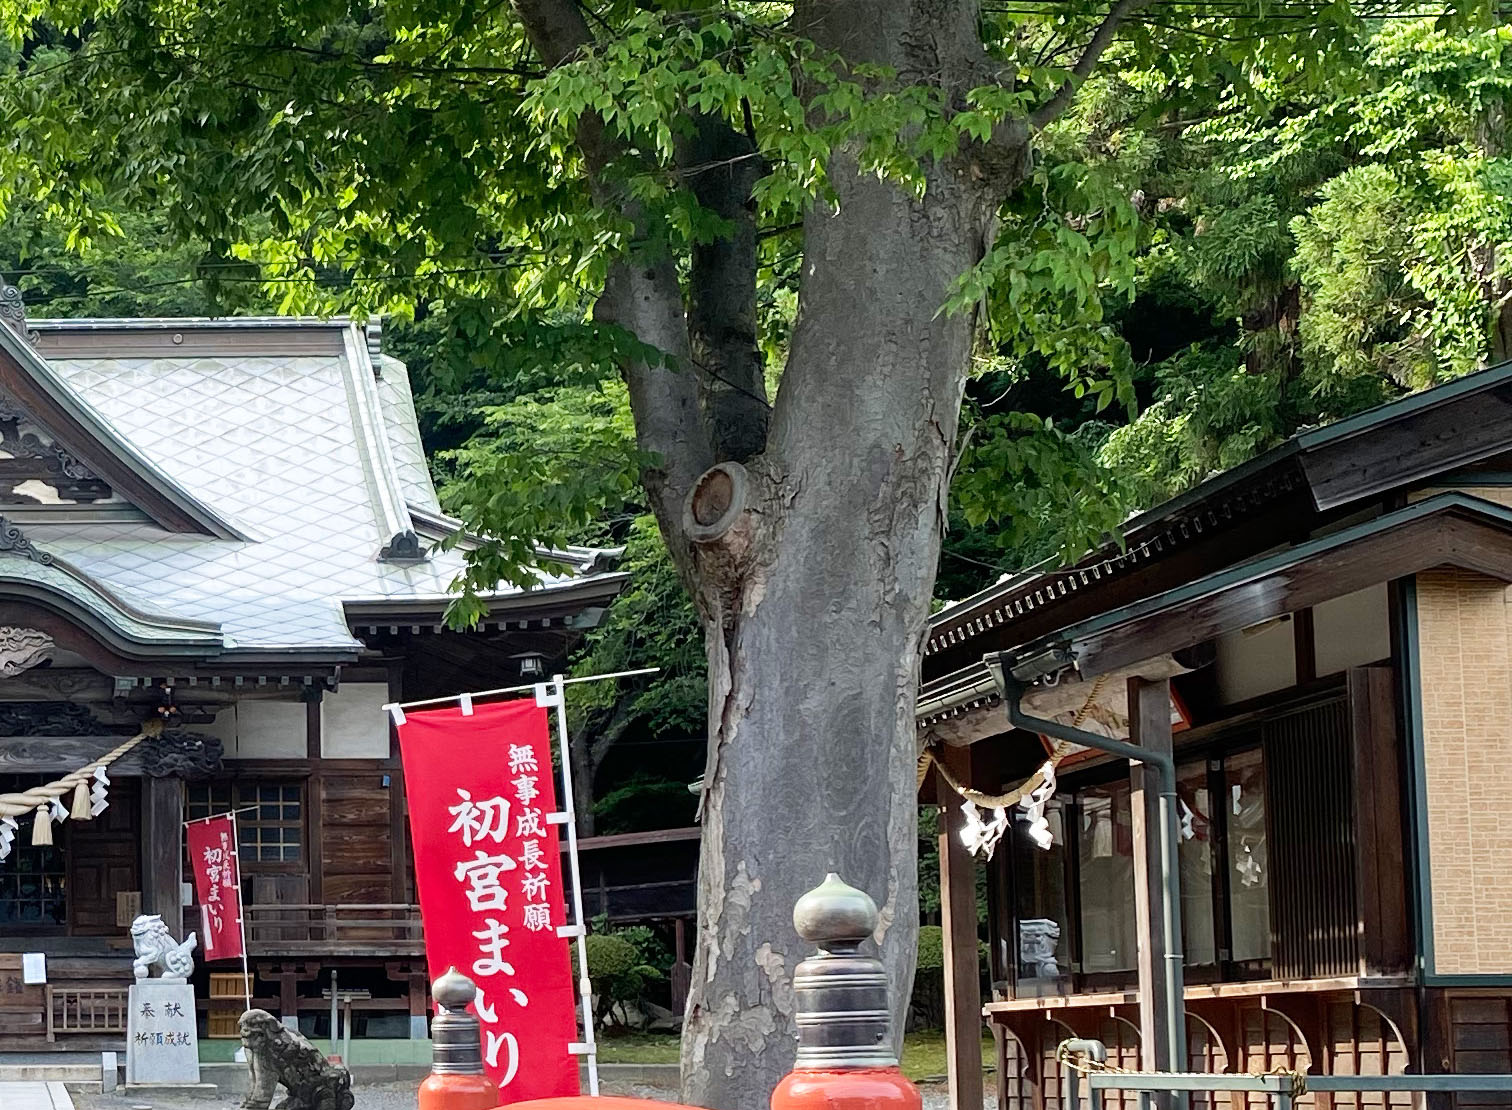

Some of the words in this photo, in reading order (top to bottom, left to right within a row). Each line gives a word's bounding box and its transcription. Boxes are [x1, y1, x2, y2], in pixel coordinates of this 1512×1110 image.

[203, 846, 225, 934] 初宮まいり
[507, 743, 553, 931] 無事成長祈願
[447, 788, 529, 1089] 初宮まいり
[134, 1031, 192, 1048] 祈願成就
